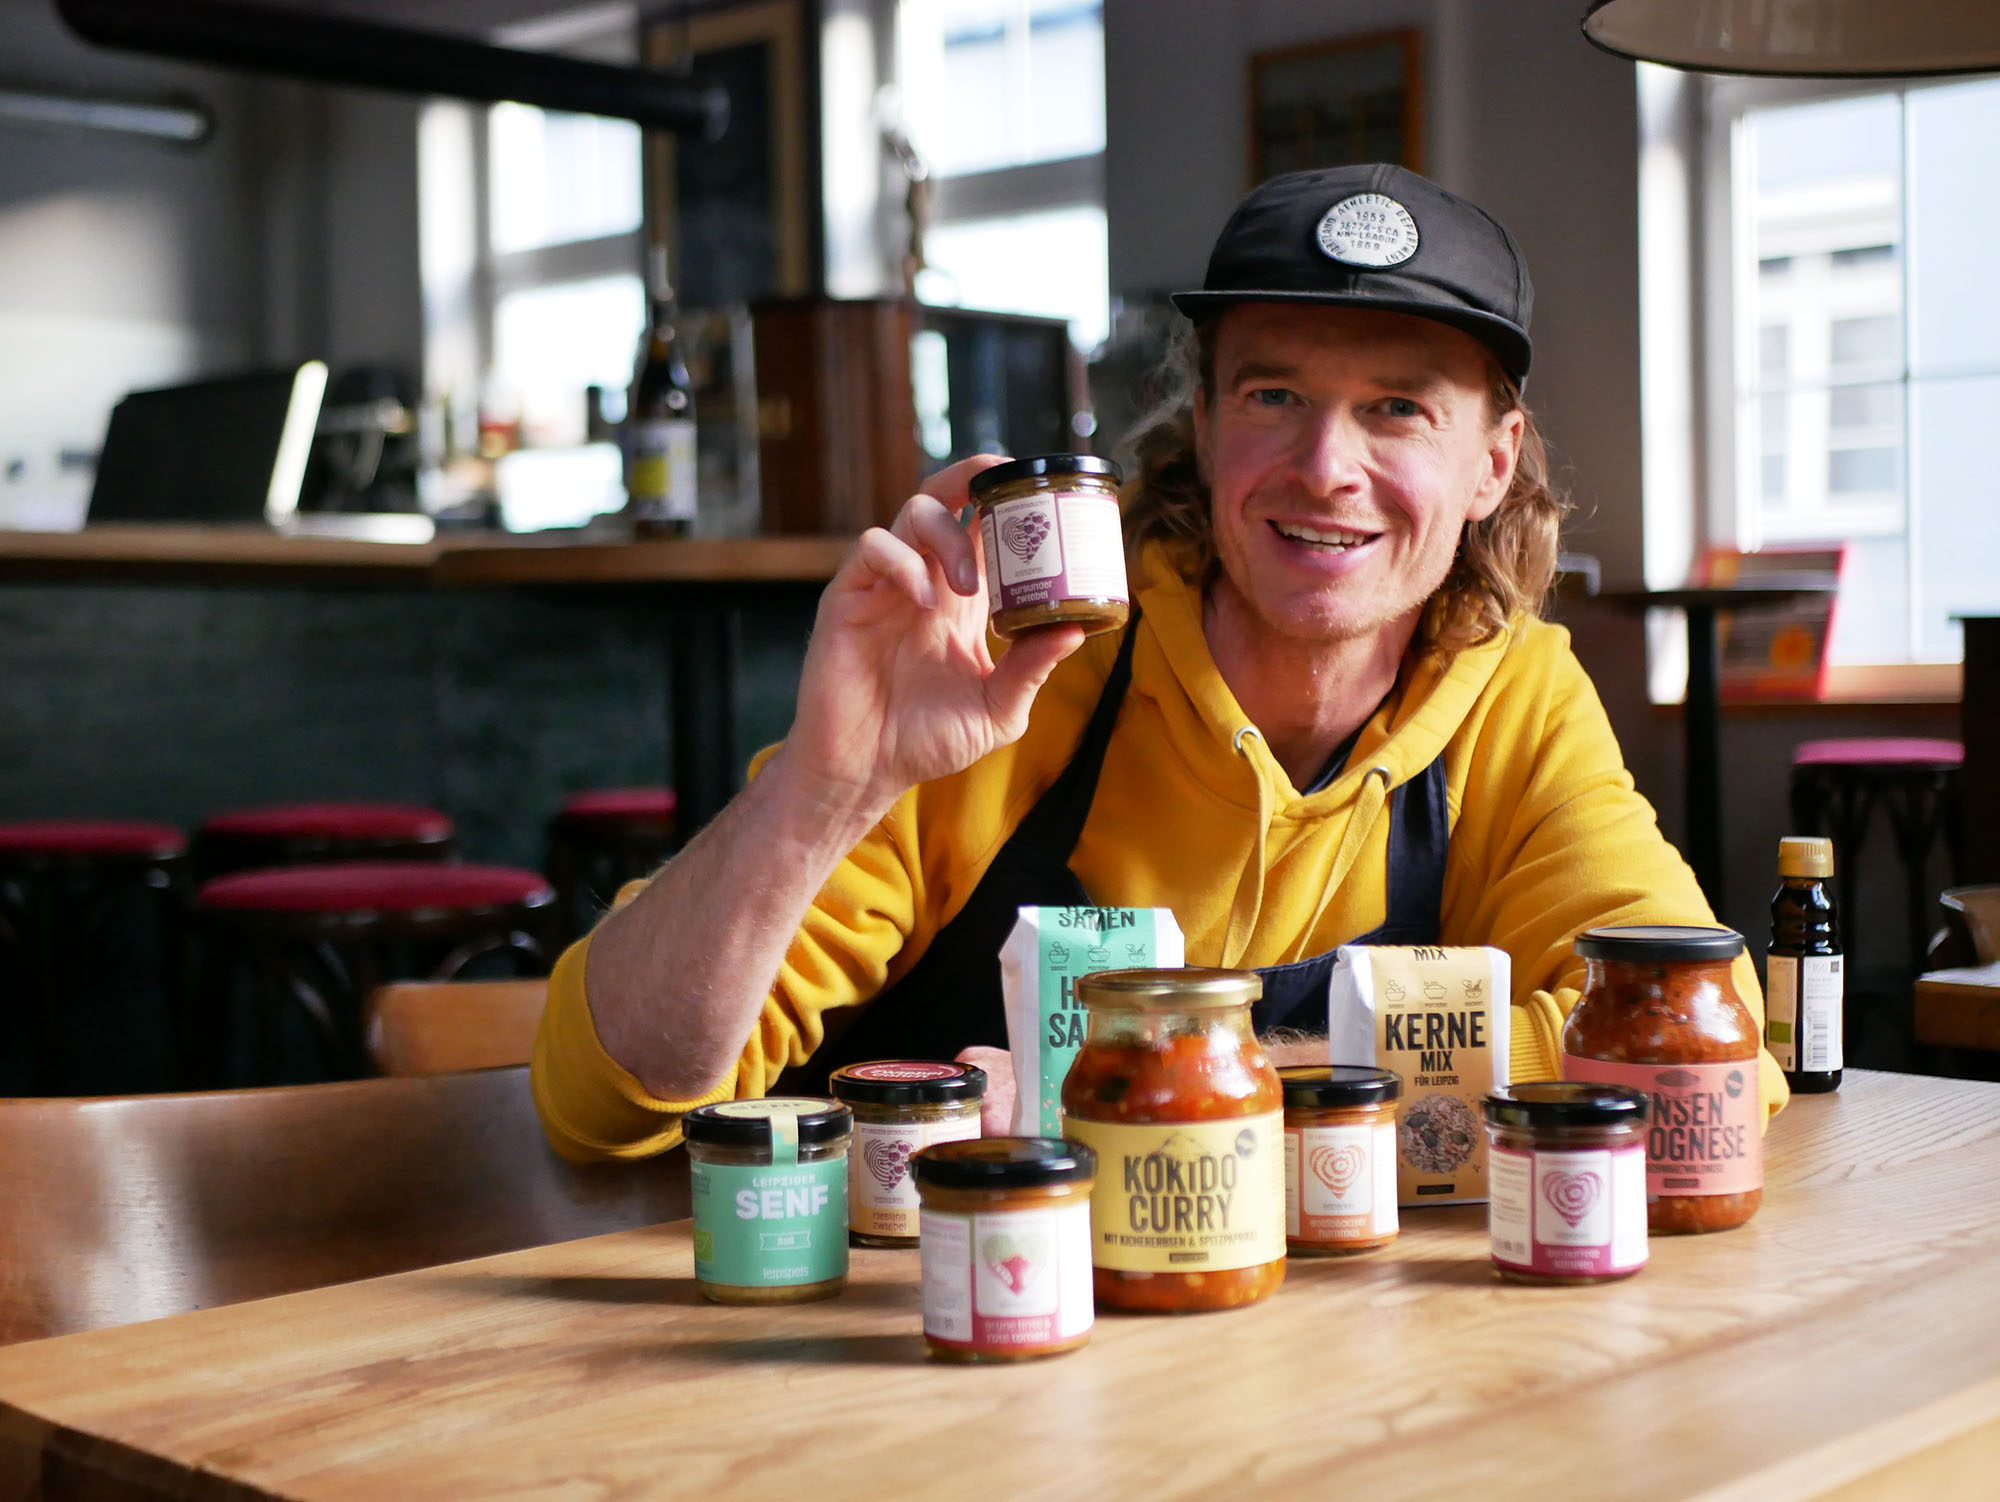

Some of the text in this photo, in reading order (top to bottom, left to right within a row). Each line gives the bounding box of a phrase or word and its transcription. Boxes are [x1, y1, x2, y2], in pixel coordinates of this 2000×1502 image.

[1058, 910, 1136, 932] SAMEN
[1413, 949, 1448, 961] MIX
[1048, 1012, 1088, 1049] SA
[1385, 1011, 1486, 1051] KERNE
[1420, 1050, 1454, 1073] MIX
[1414, 1074, 1460, 1087] FÜR LEIPZIG
[1652, 1091, 1723, 1126] NSEN
[1649, 1125, 1745, 1162] OGNESE
[736, 1184, 829, 1220] SENF
[1129, 1193, 1233, 1233] CURRY
[1104, 1232, 1118, 1246] MIT
